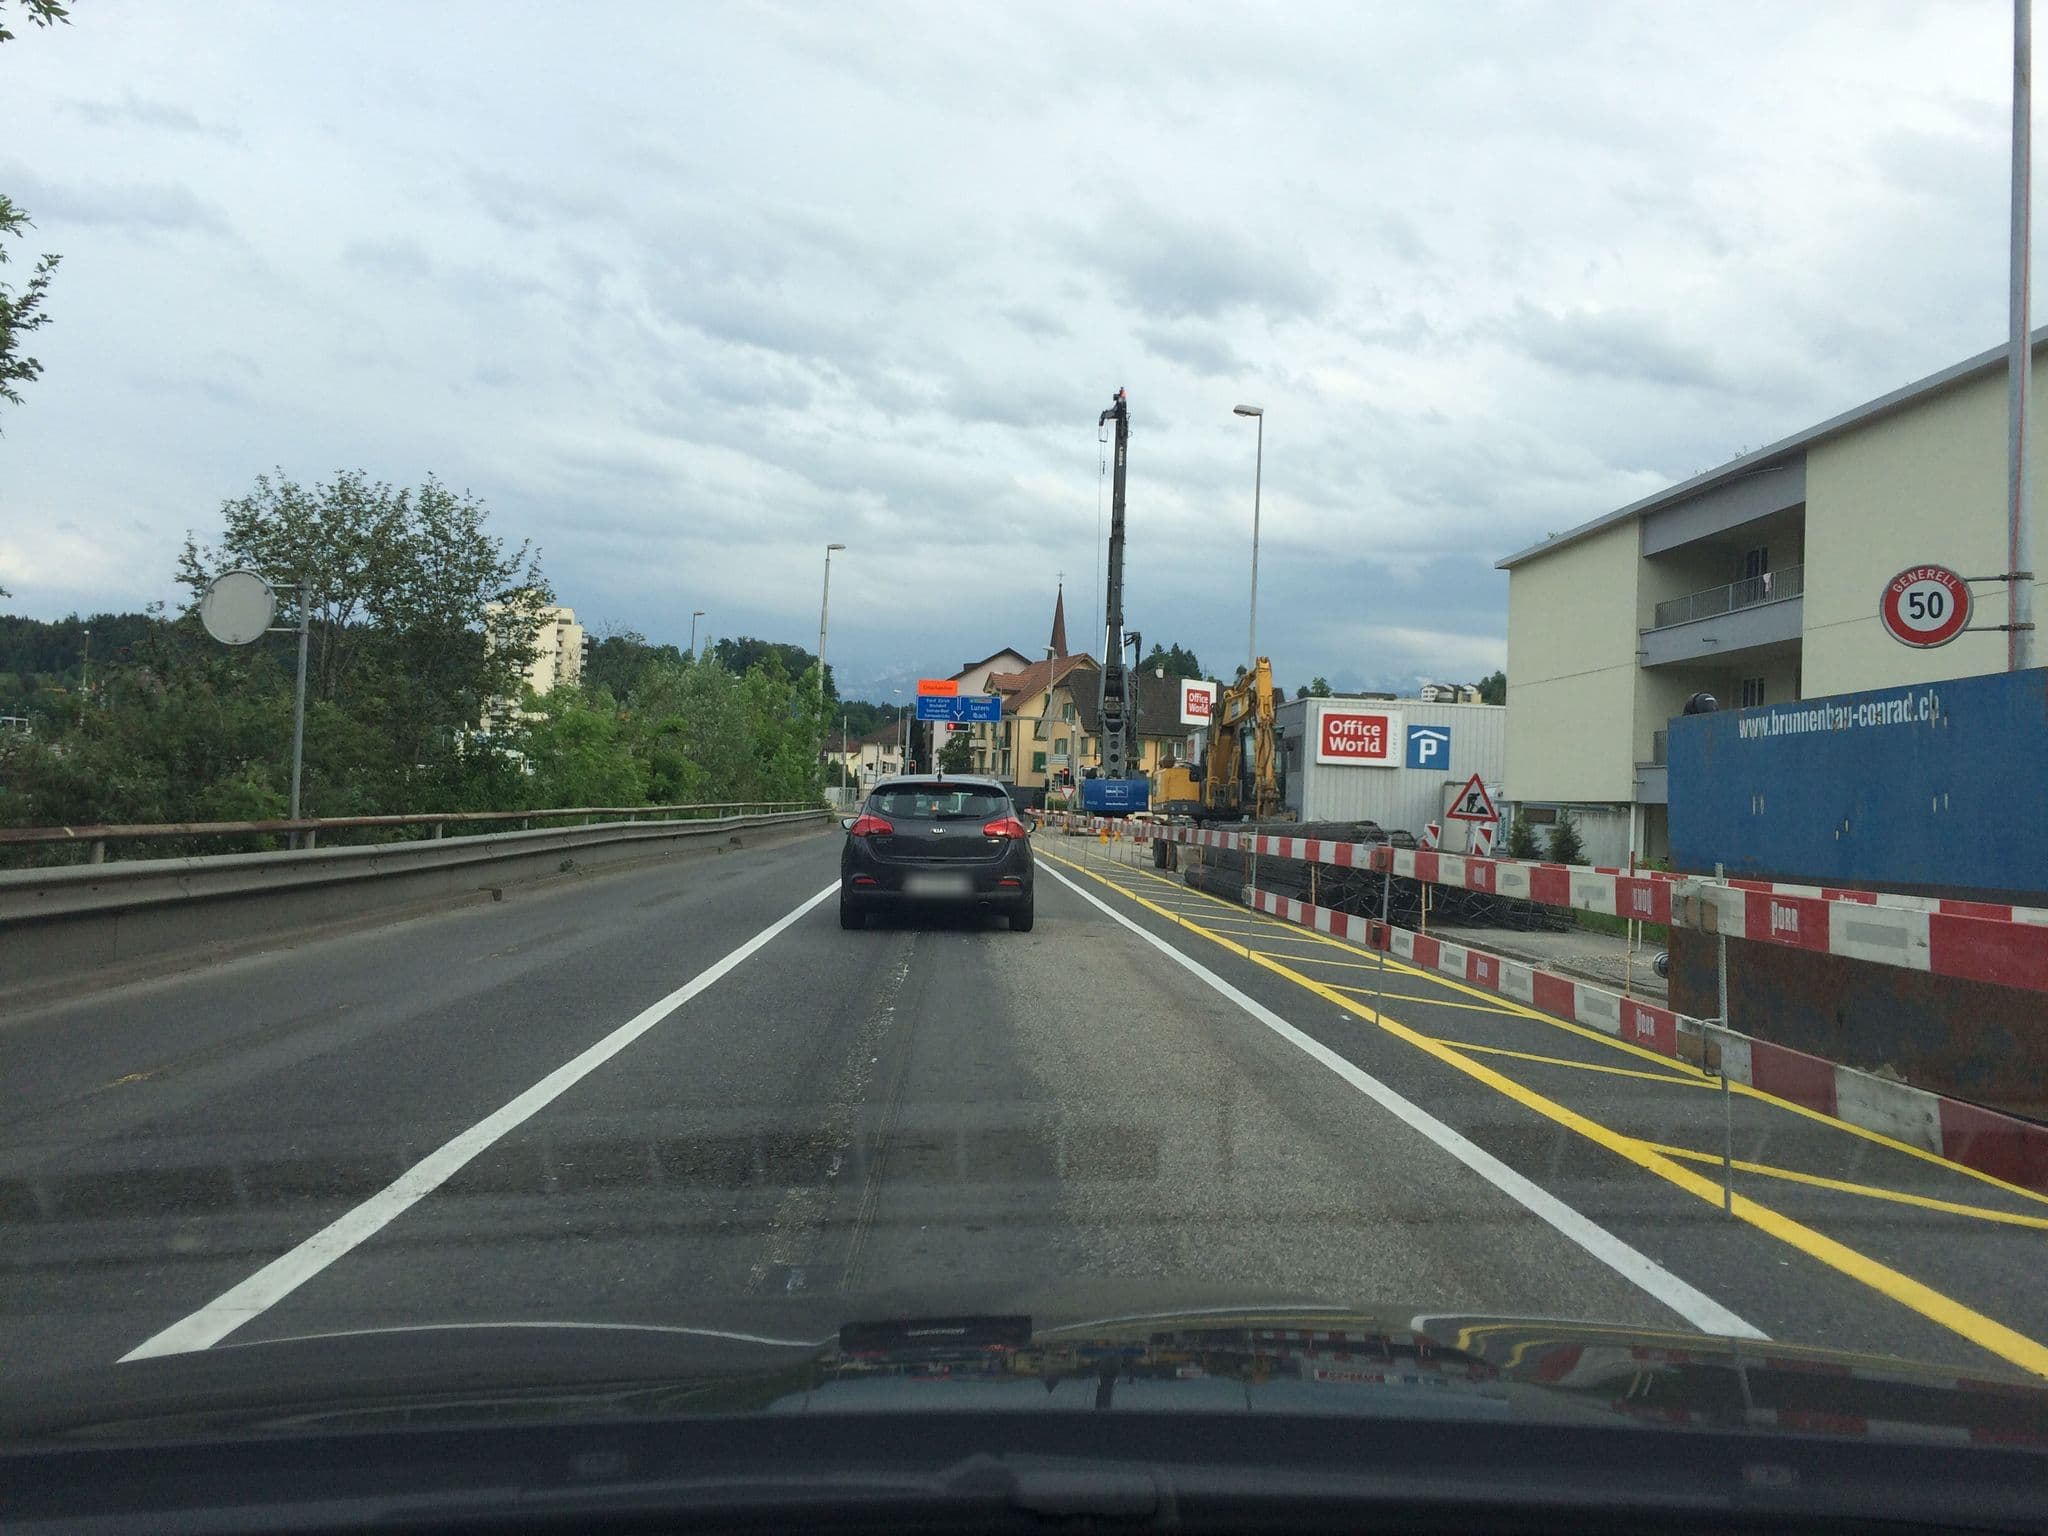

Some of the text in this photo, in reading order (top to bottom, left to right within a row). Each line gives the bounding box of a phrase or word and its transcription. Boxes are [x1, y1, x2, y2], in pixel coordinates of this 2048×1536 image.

[1893, 569, 1955, 592] GENERELL
[1908, 591, 1944, 620] 50
[1188, 692, 1209, 704] Office
[1188, 702, 1209, 714] World
[1738, 689, 1940, 740] www.brunnenbau-conrad.ch
[1329, 719, 1381, 736] Office
[1329, 736, 1381, 753] World
[1419, 738, 1438, 764] P
